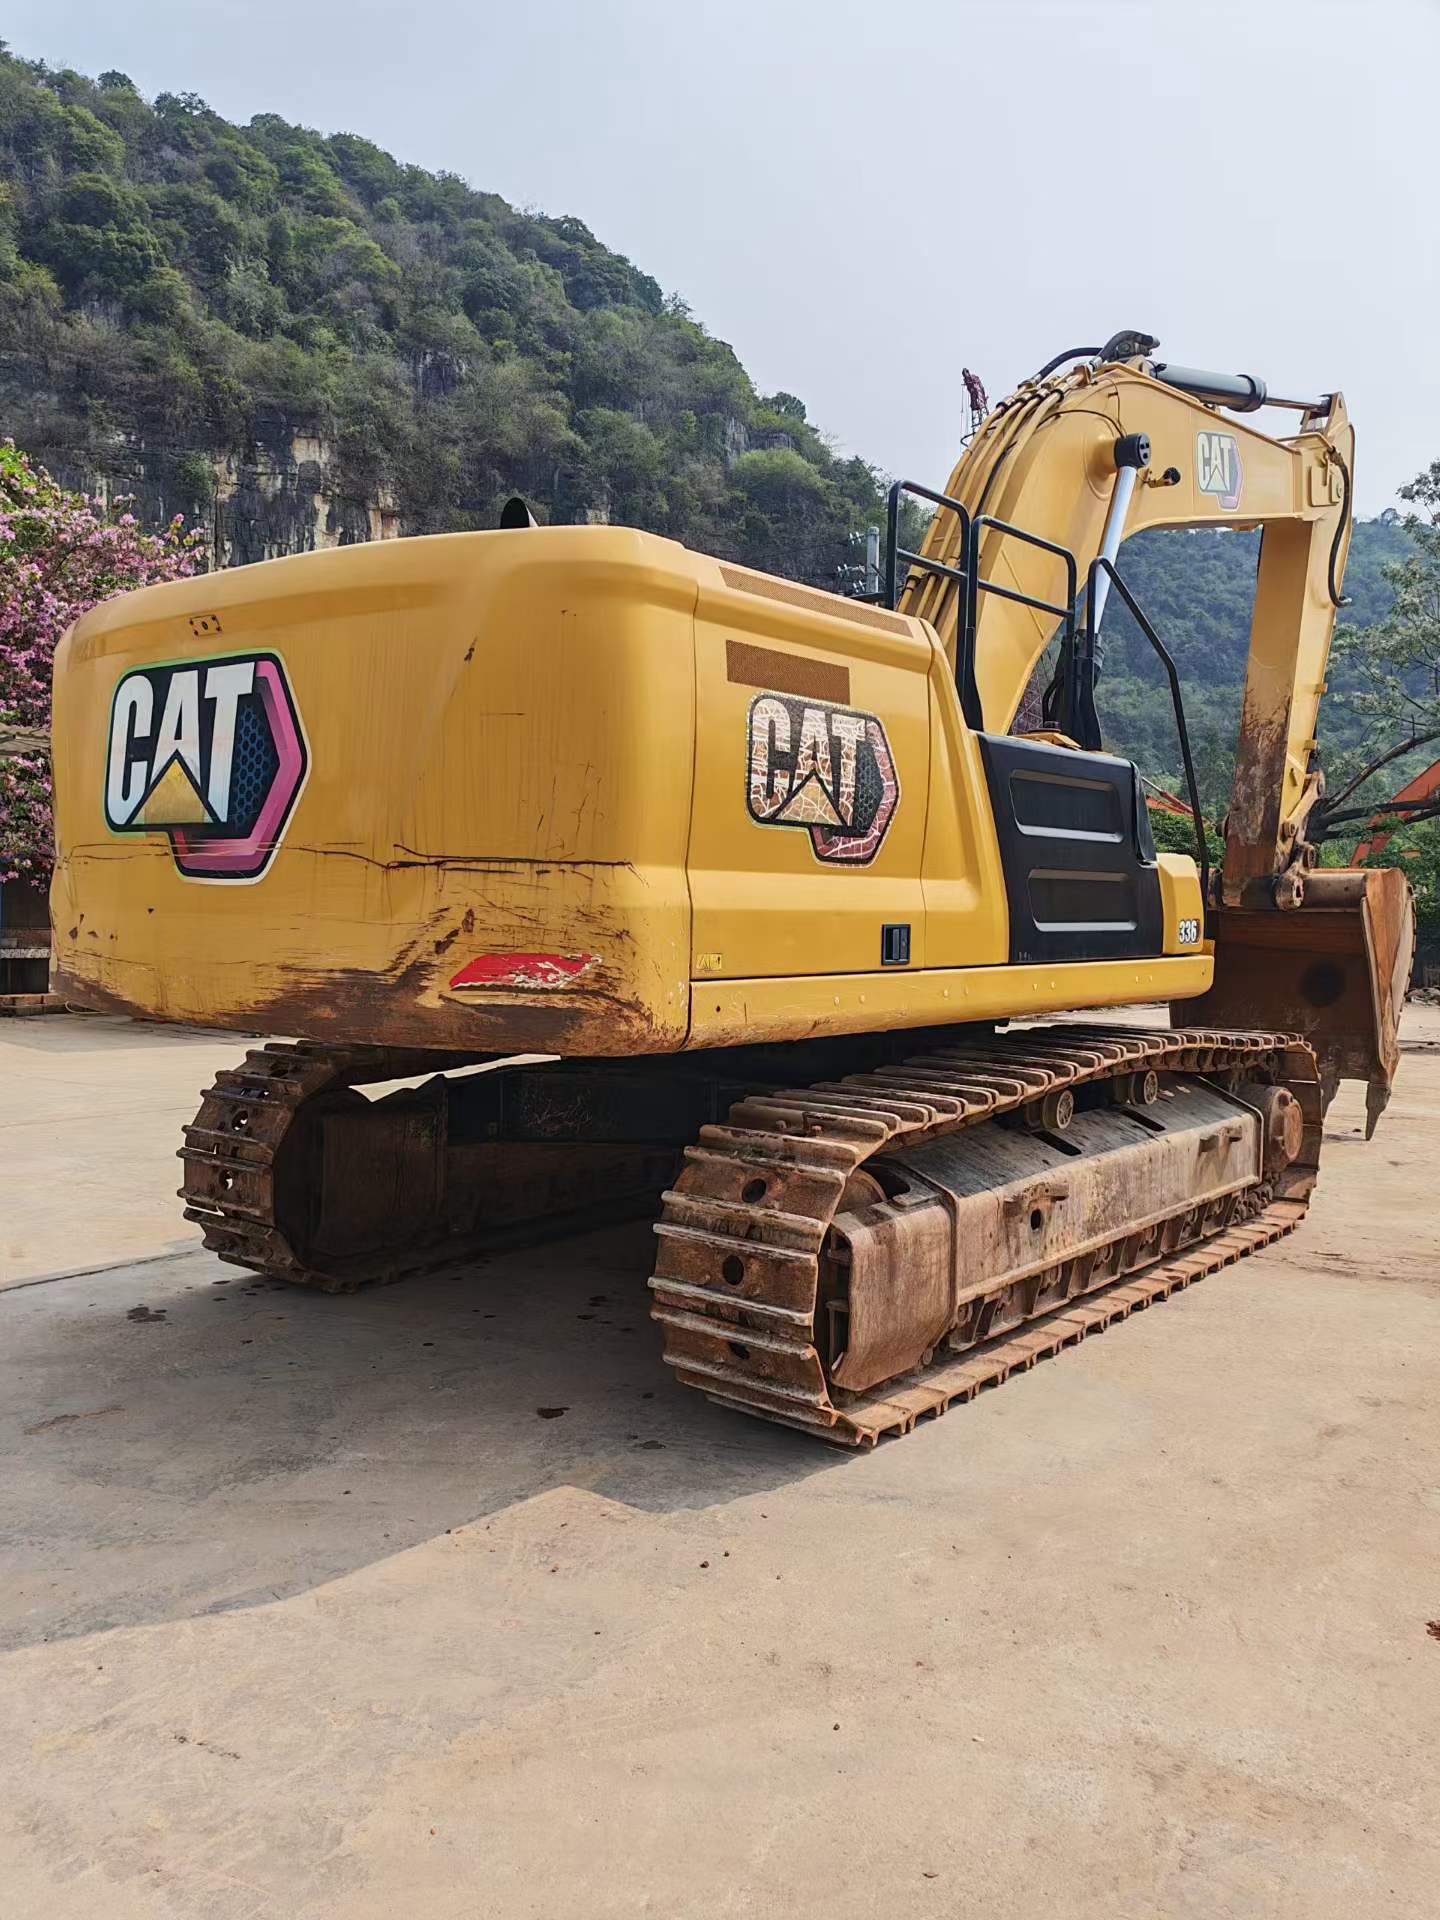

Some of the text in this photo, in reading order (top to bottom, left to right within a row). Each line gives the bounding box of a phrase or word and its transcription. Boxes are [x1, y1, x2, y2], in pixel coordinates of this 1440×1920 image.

[1197, 433, 1232, 491] CAT
[107, 661, 255, 825] CAT
[751, 698, 866, 827] CAT
[1179, 919, 1198, 943] 336
